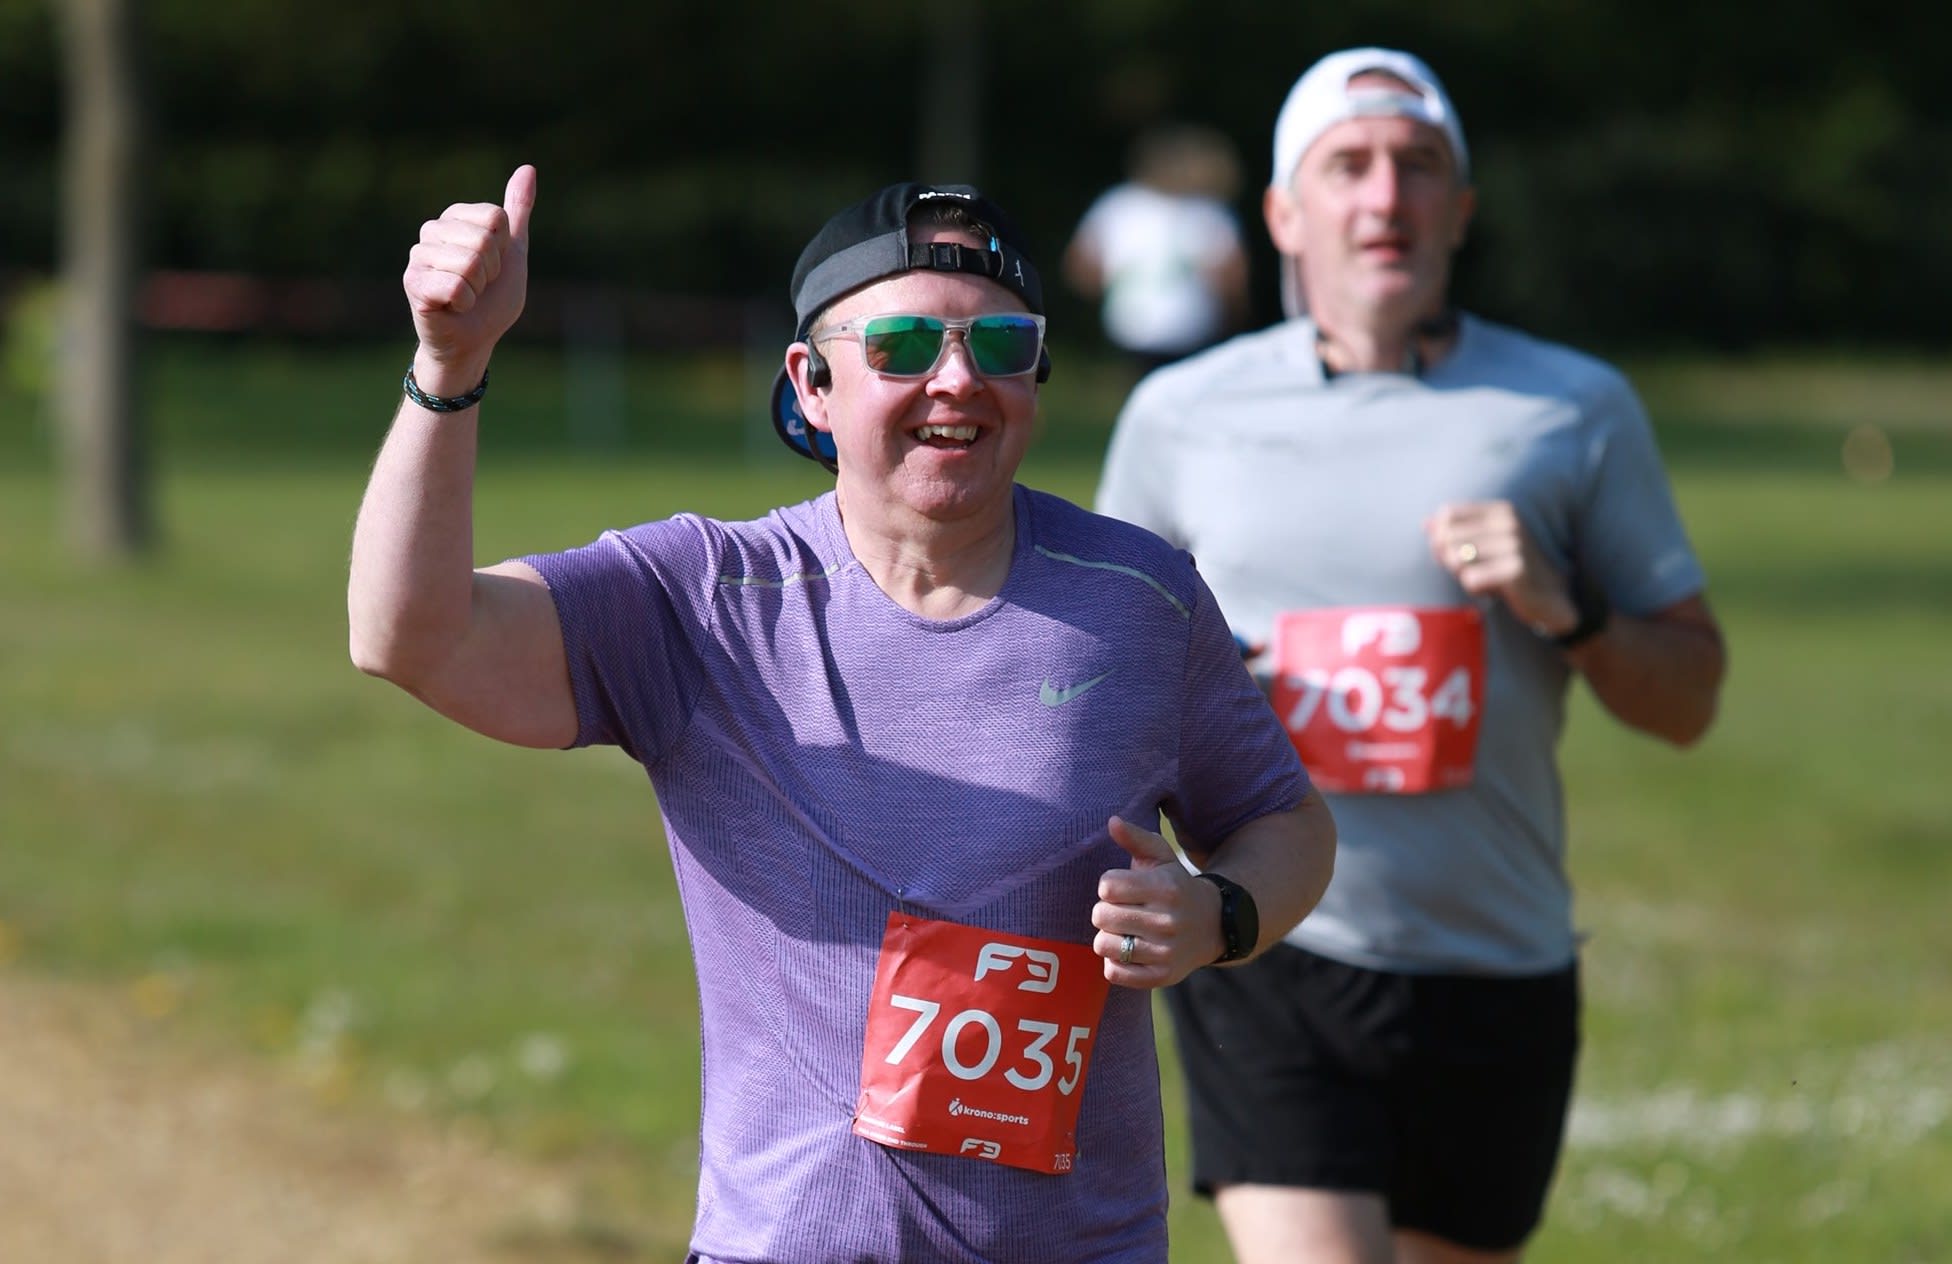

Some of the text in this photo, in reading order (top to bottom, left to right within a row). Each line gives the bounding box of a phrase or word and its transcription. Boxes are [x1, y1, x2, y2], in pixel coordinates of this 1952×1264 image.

[1286, 666, 1475, 733] 7034
[885, 993, 1090, 1096] 7035
[963, 1106, 1029, 1126] krono:sports
